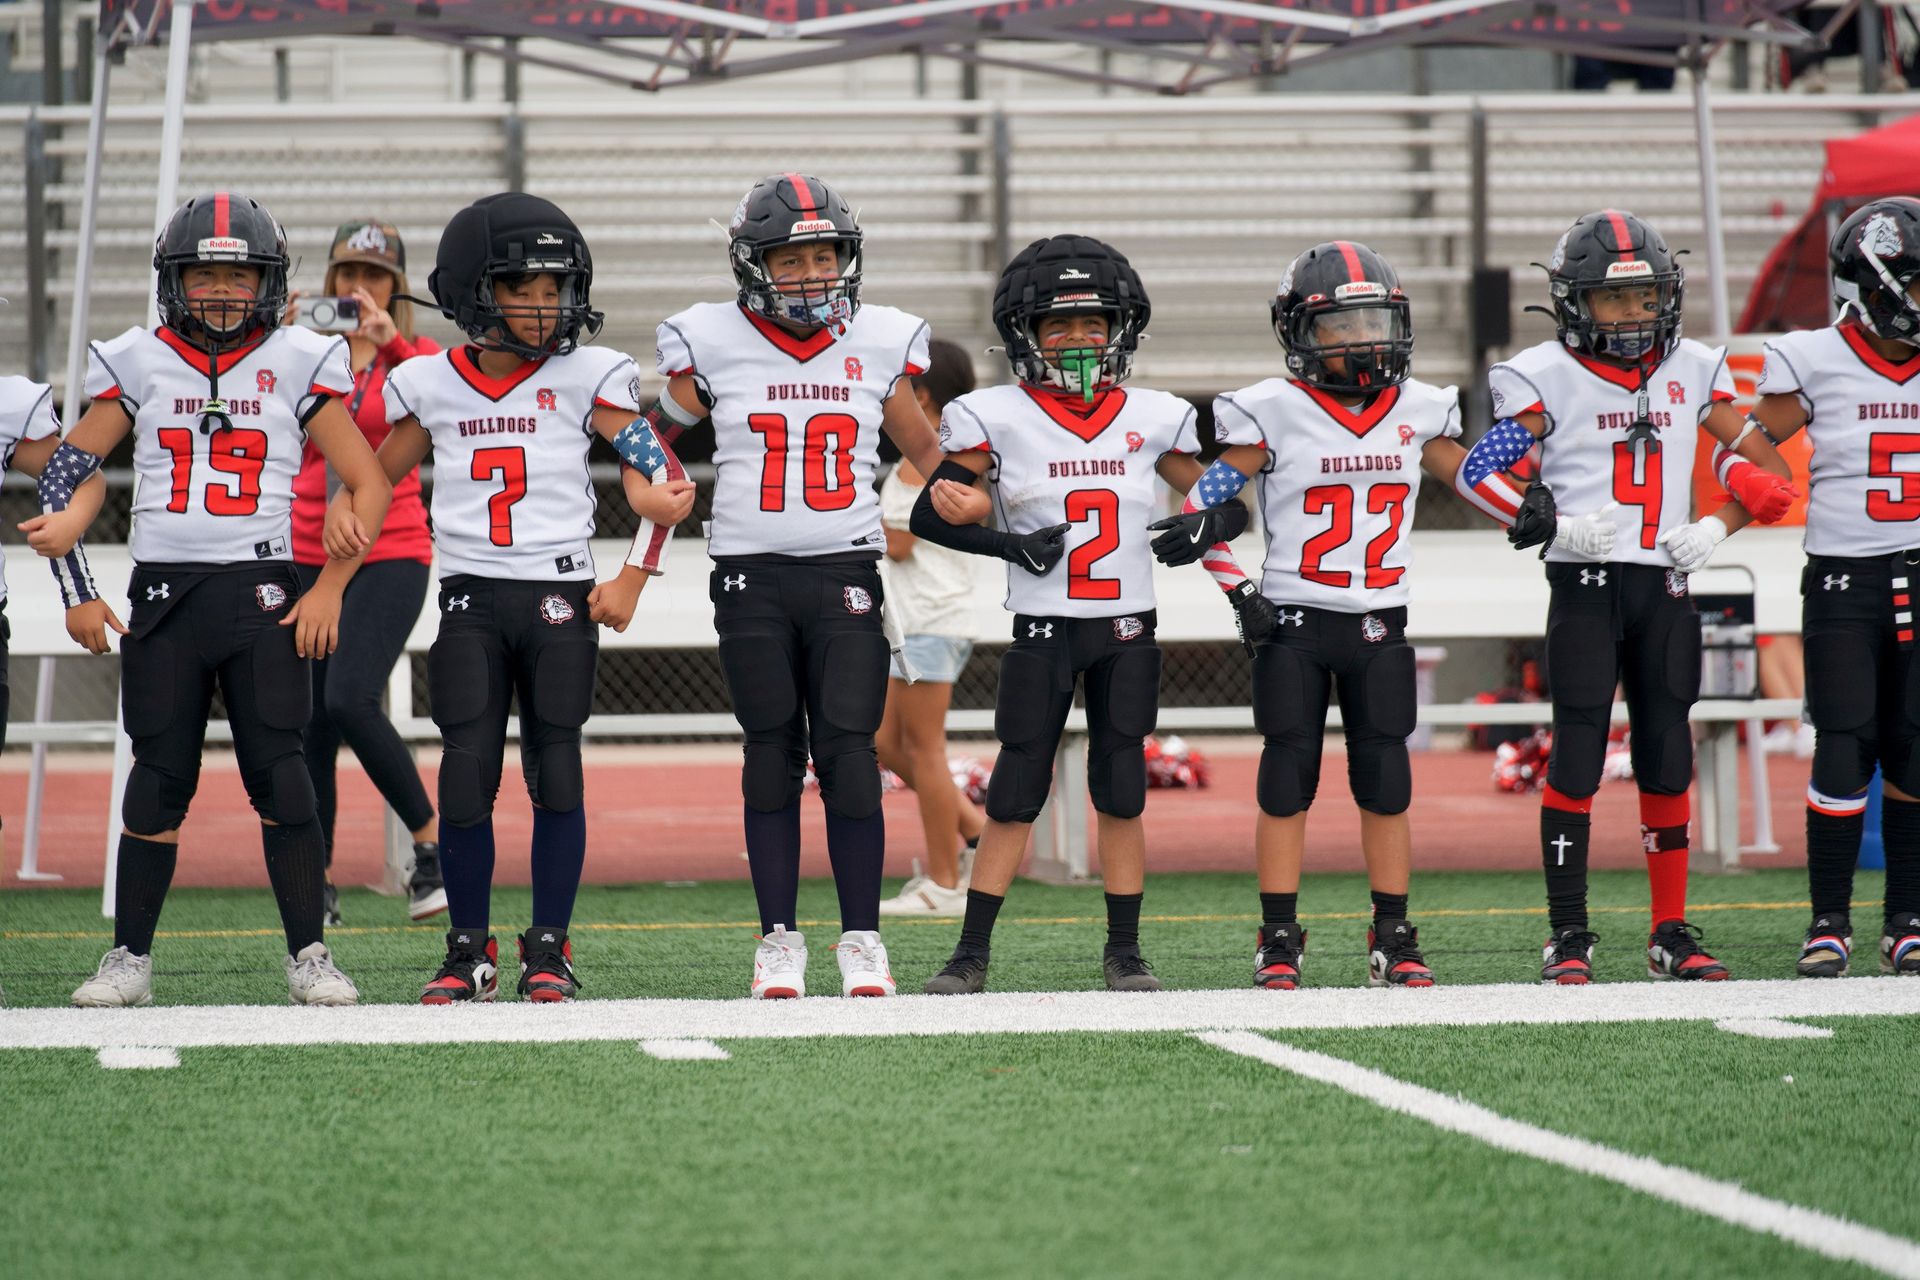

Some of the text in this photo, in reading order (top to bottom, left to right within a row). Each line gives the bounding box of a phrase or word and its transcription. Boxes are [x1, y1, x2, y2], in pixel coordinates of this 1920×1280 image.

[797, 222, 831, 232] Riddell
[209, 240, 238, 248] Riddell
[1612, 264, 1647, 273] Riddell
[1346, 285, 1373, 294] Riddell
[767, 384, 850, 402] BULLDOGS
[173, 398, 262, 416] BUOGS
[458, 417, 536, 437] BULLDOGS
[1597, 411, 1672, 430] BULLOGS
[157, 427, 269, 517] 19
[748, 413, 860, 513] 10
[1048, 460, 1126, 478] BULLDOGS
[1320, 454, 1402, 474] BULLDOGS
[1866, 431, 1920, 523] 5
[470, 446, 528, 547] 7
[1612, 439, 1663, 550] 4
[1064, 488, 1121, 601] 2
[1298, 482, 1411, 589] 22
